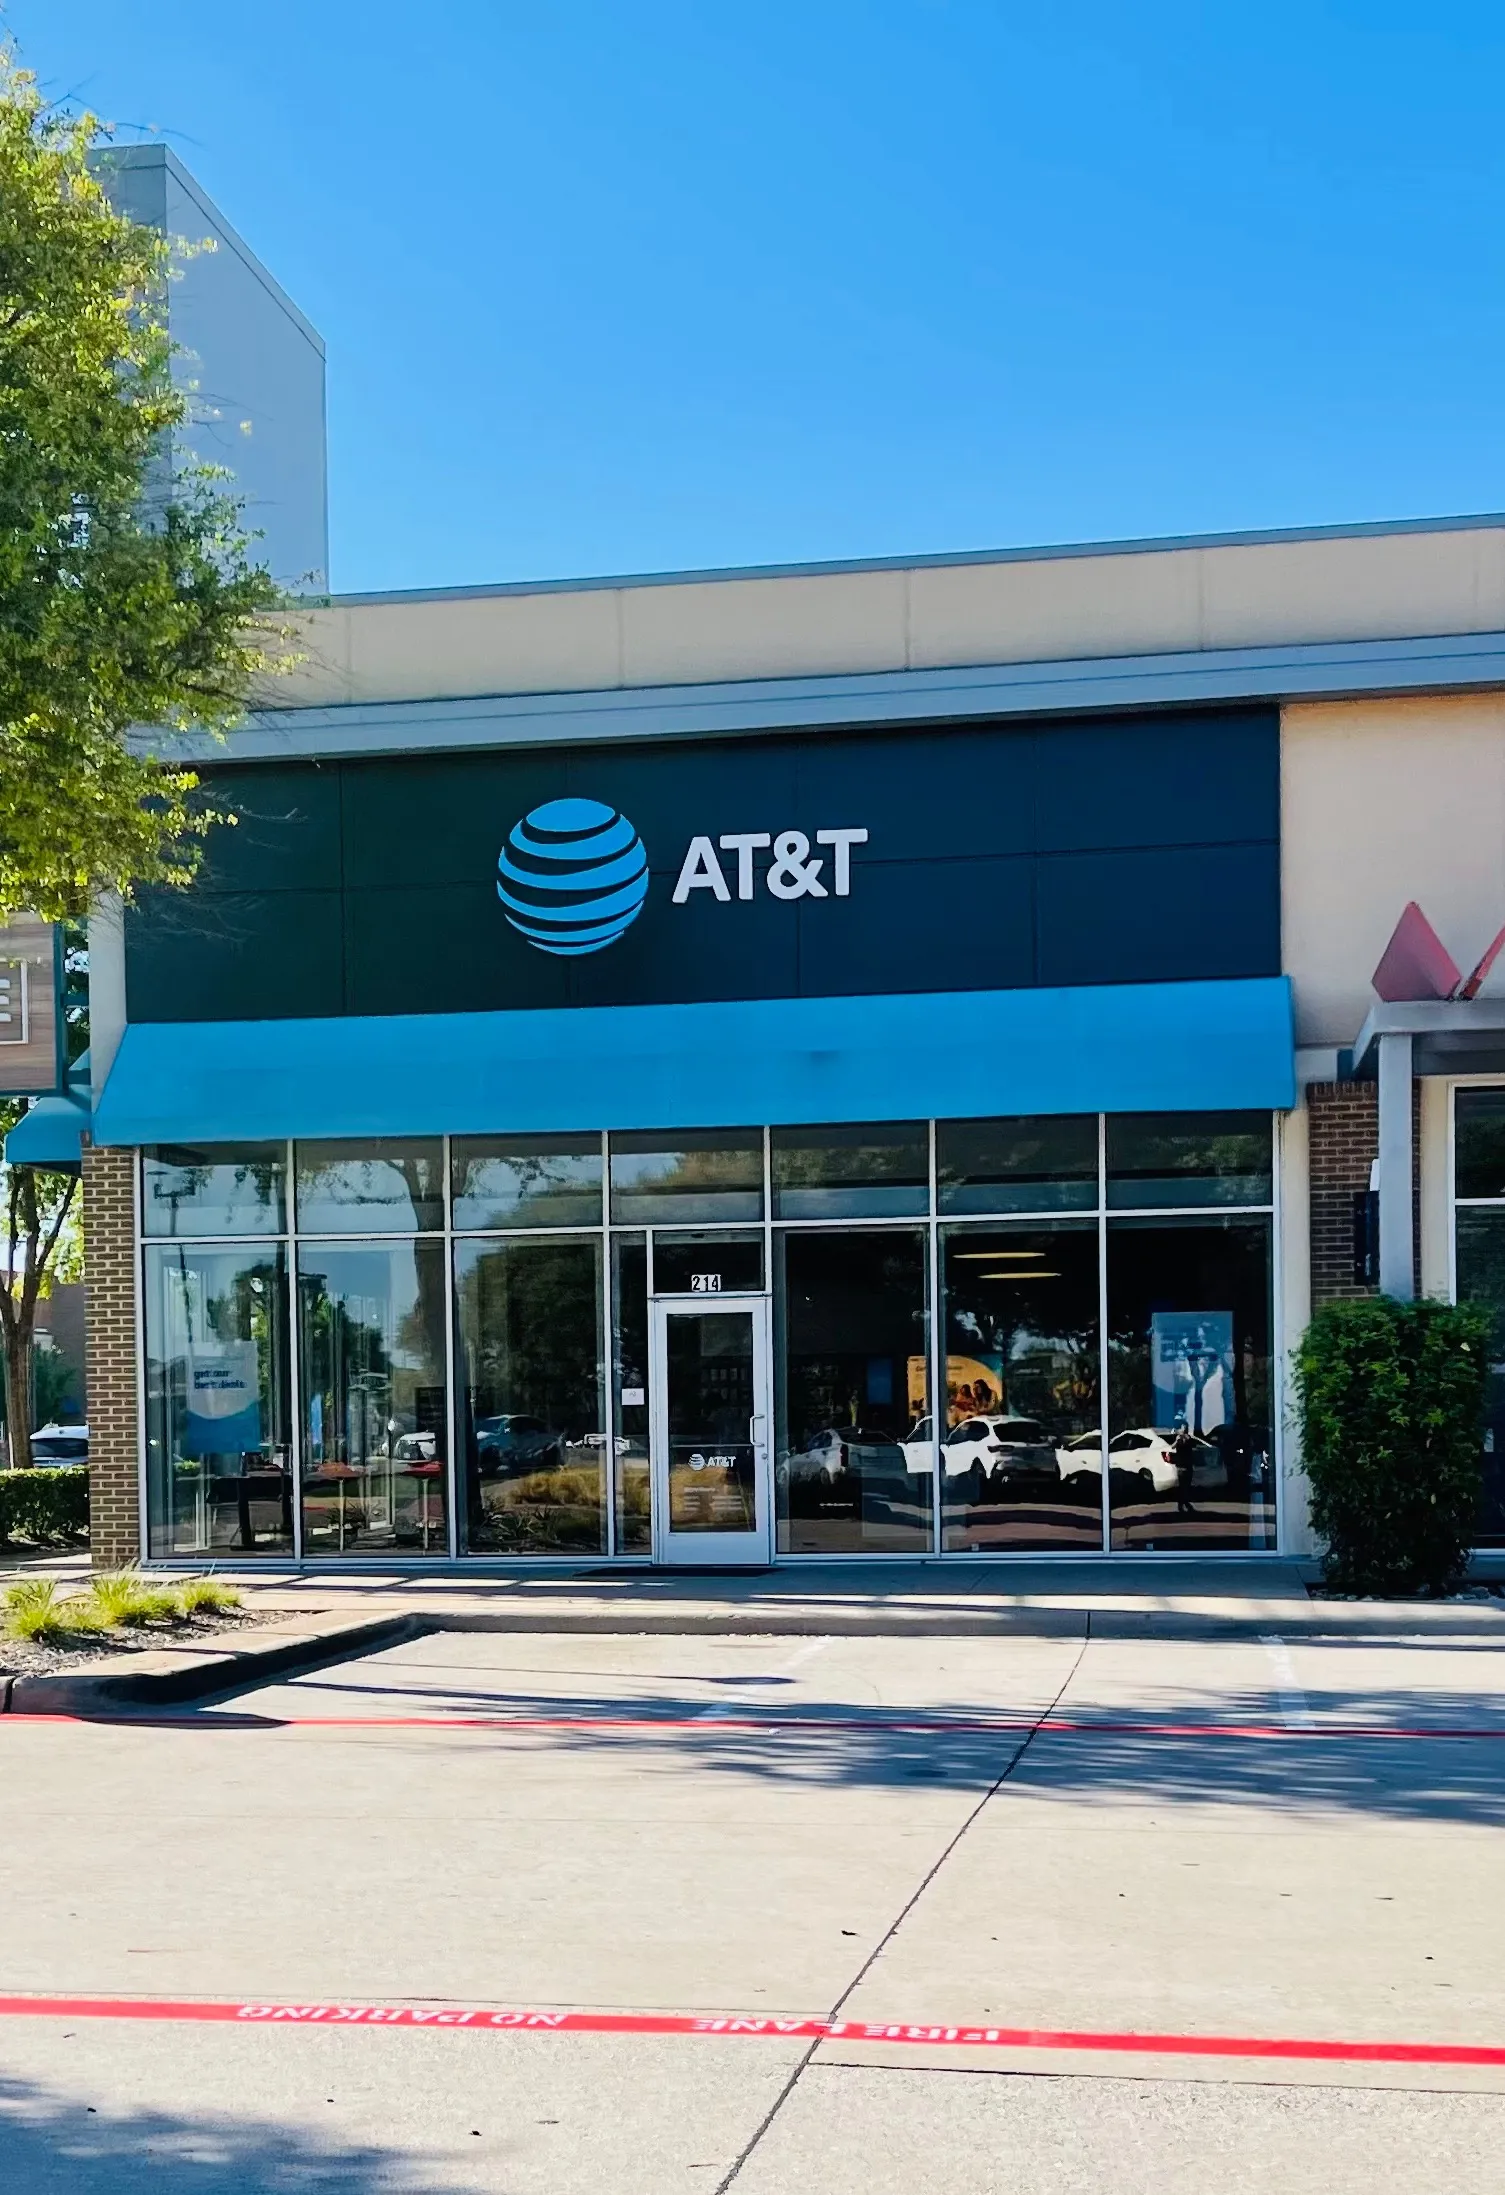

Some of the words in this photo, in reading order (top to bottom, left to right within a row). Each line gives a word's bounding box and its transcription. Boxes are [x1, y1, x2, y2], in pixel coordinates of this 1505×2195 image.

[672, 828, 869, 904] AT&T
[692, 1275, 719, 1291] 214
[707, 1455, 737, 1468] AT&T
[237, 2005, 476, 2023] PARKING
[490, 2012, 568, 2026] NO
[690, 2018, 848, 2035] LANE
[864, 2024, 1000, 2041] FIRE
